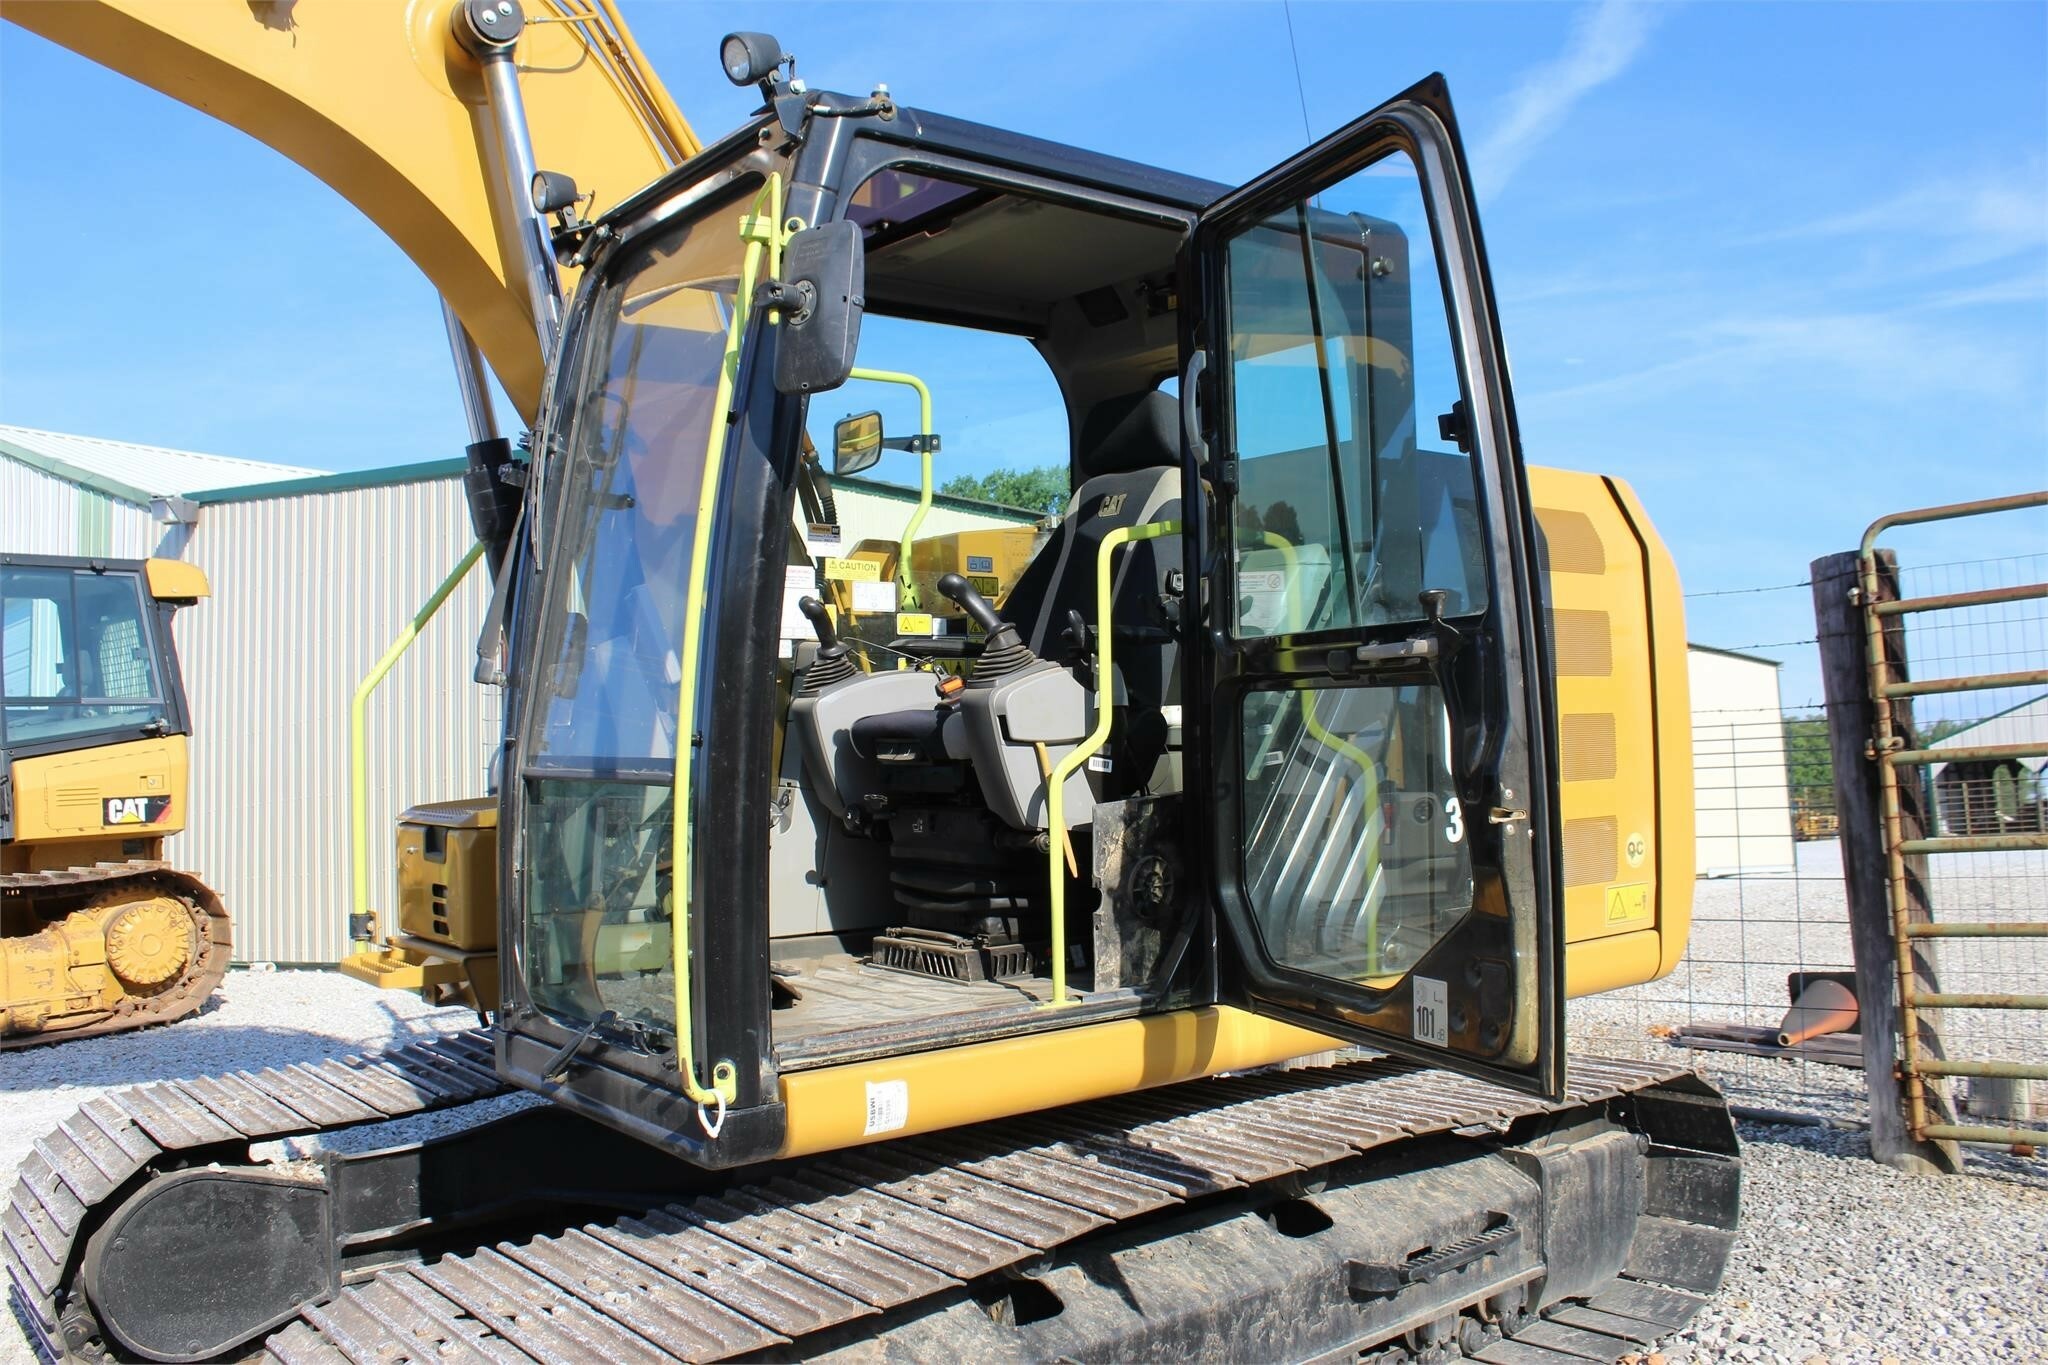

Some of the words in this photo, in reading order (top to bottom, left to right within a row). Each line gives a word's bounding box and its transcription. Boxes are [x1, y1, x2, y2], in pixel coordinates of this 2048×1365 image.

[1098, 493, 1128, 517] CAT
[839, 562, 877, 572] CAUTION
[108, 798, 148, 823] CAT
[1417, 1005, 1435, 1039] 101
